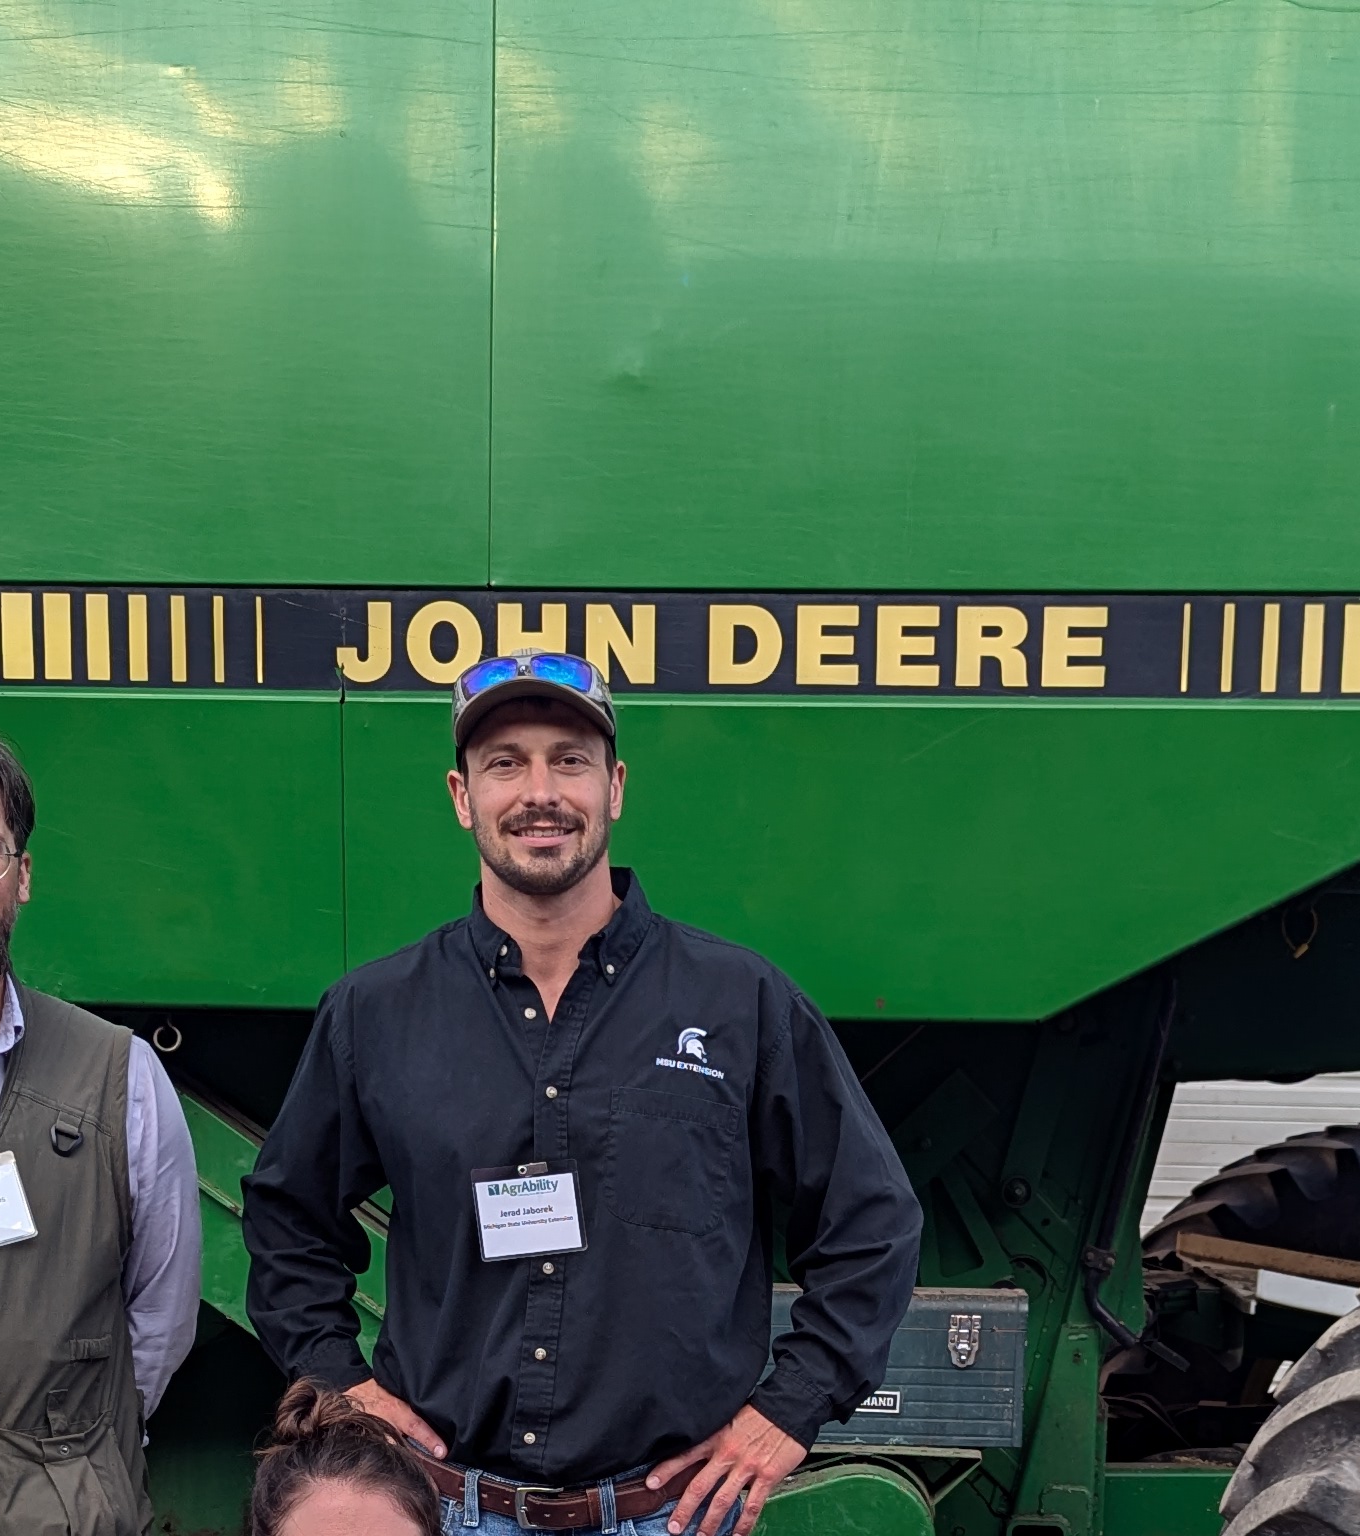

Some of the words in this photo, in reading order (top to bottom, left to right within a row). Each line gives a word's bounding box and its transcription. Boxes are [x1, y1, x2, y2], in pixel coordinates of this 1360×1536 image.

[336, 601, 656, 685] JOHN
[709, 604, 1109, 688] DEERE
[655, 1057, 676, 1068] MSU
[677, 1061, 725, 1080] EXTENSION
[501, 1178, 559, 1197] AgrAbility
[500, 1208, 521, 1218] Jerad
[522, 1204, 554, 1216] Jaborek
[861, 1396, 894, 1407] HAND
